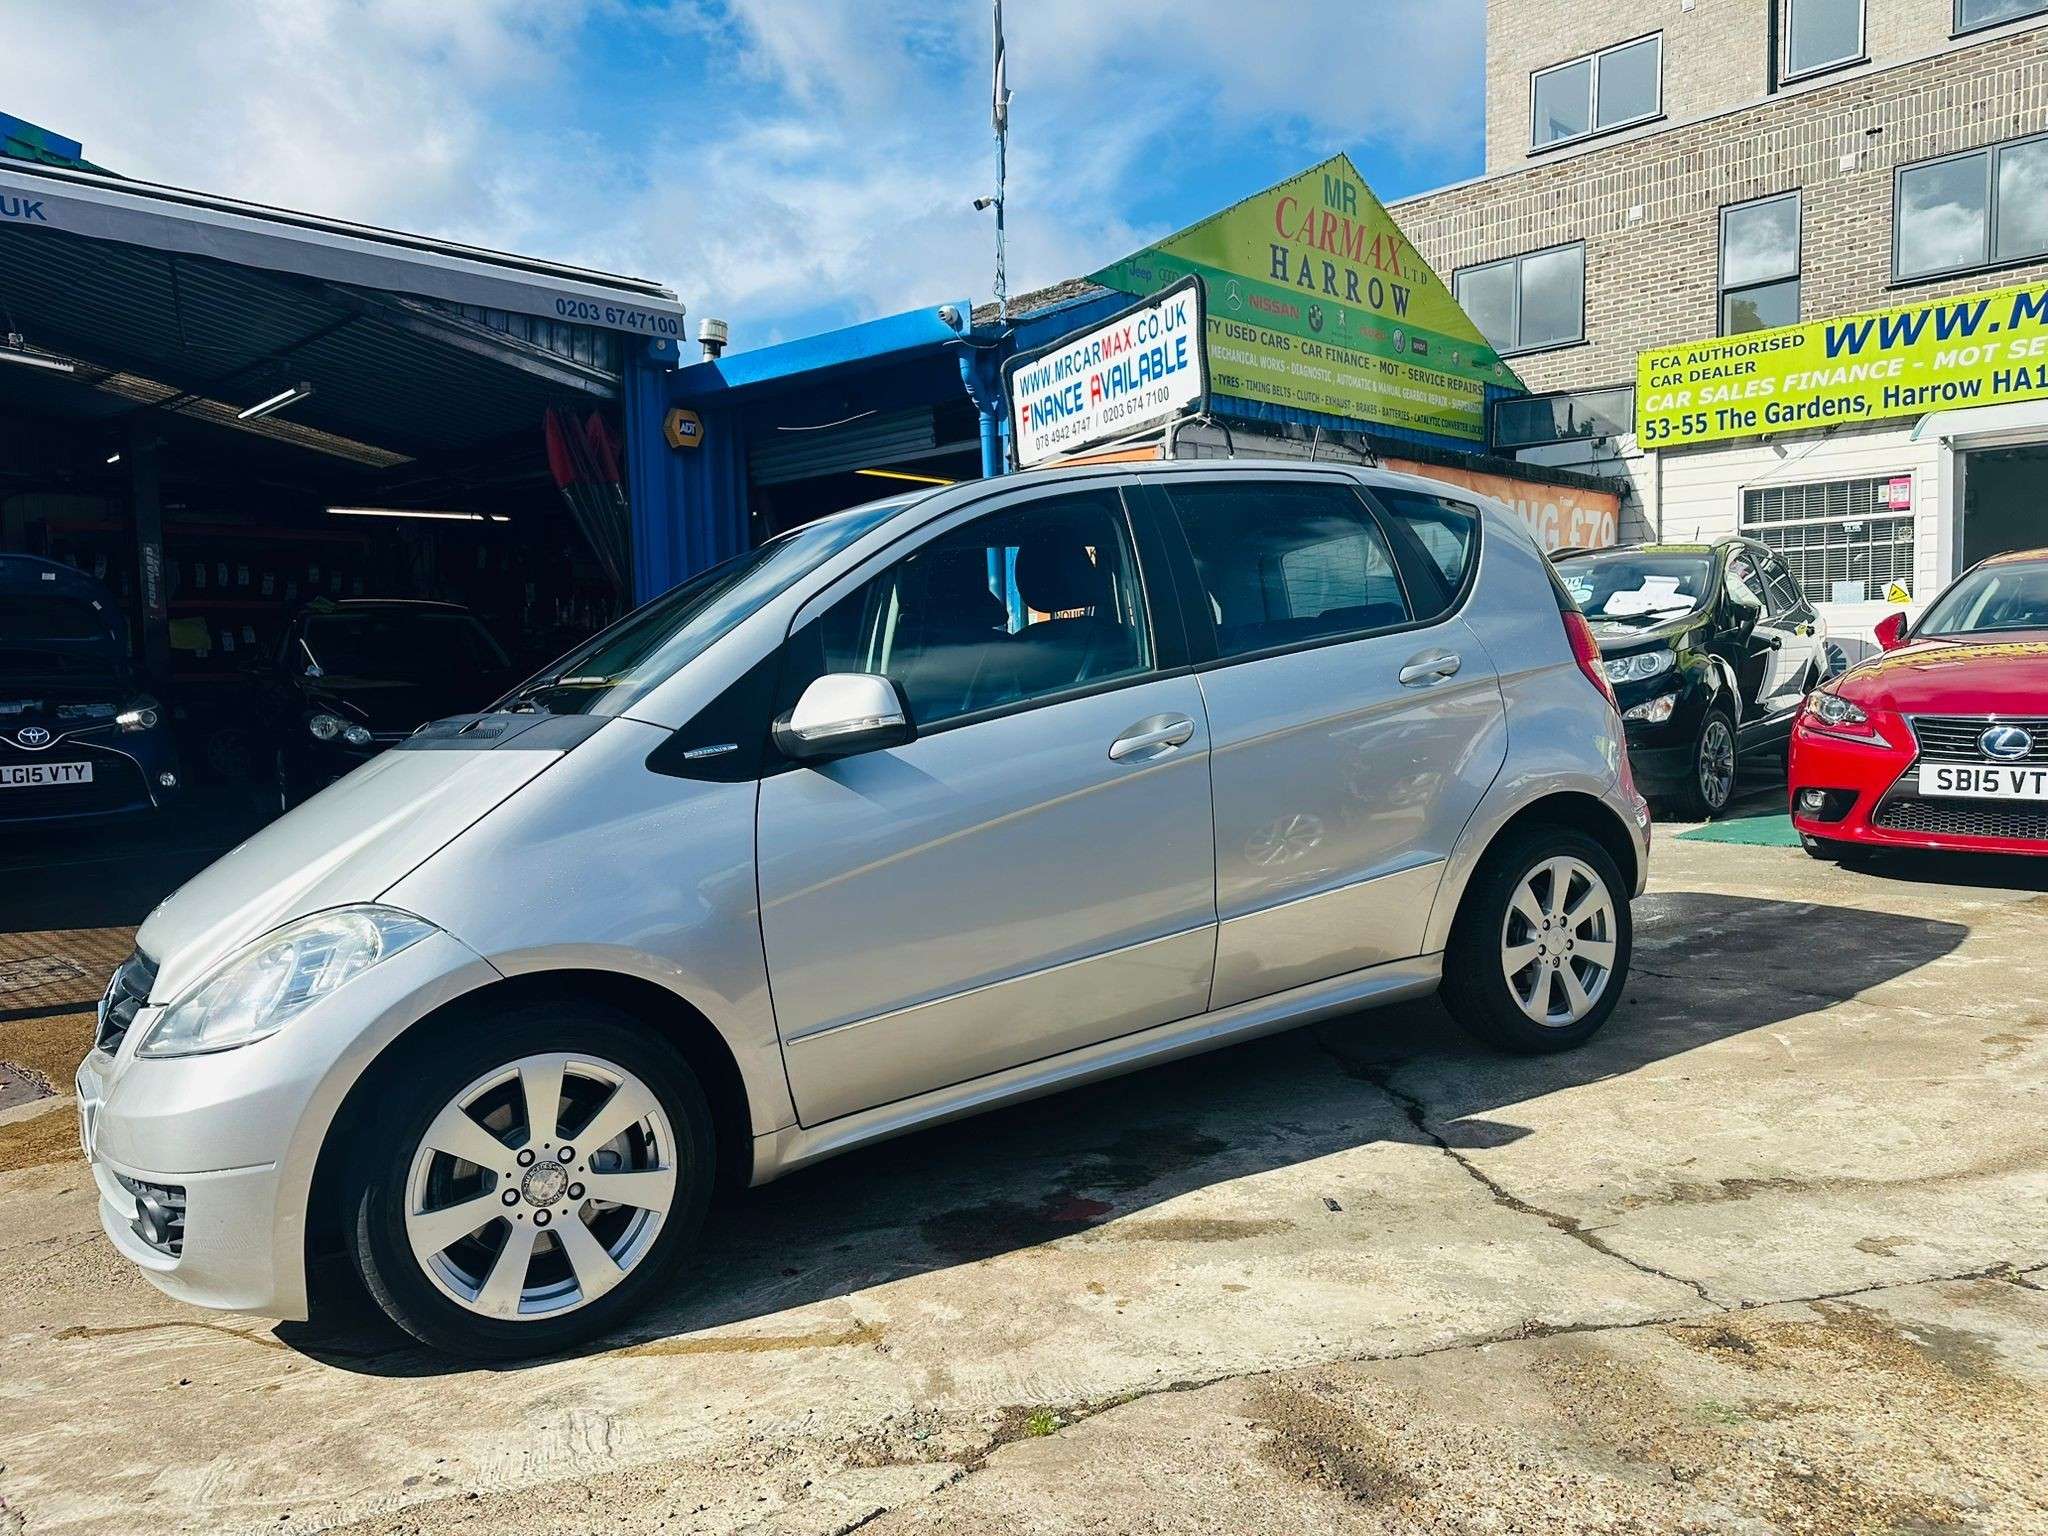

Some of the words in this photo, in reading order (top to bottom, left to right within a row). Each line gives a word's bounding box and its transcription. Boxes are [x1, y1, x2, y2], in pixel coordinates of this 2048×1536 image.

[1324, 174, 1357, 216] MR
[1275, 196, 1403, 276] CARMAX
[1403, 266, 1428, 285] LTD
[1129, 261, 1152, 282] Jeep
[1270, 243, 1411, 318] HARROW
[555, 298, 600, 321] 0203
[605, 307, 678, 334] 6747100
[1249, 294, 1300, 320] NISSAN
[1019, 300, 1187, 398] WWW.MRCARMAX.CO.UK
[1211, 344, 1258, 367] MECHANICAL
[1260, 356, 1285, 372] WORKS
[1225, 323, 1257, 343] USED
[1261, 332, 1290, 350] CARS
[1301, 342, 1322, 359] CAR
[1325, 347, 1370, 369] FINANCE
[1380, 360, 1399, 376] MOT
[1408, 368, 1445, 387] SERVICE
[1447, 378, 1483, 395] REPAIRS
[1650, 356, 1682, 371] FCA
[1687, 334, 1805, 365] AUTHORISED
[1021, 381, 1084, 437] FINANCE
[1091, 335, 1188, 409] AVAILABLE
[1645, 390, 1692, 413] CAR
[1699, 377, 1776, 405] SALES
[1782, 358, 1904, 393] FINANCE
[1933, 343, 2001, 370] MOT
[2007, 335, 2048, 360] SE
[1650, 373, 1683, 388] CAR
[1689, 361, 1757, 383] DEALER
[1218, 373, 1240, 389] TYRES
[1246, 379, 1271, 394] TIMING
[1272, 384, 1291, 399] BELTS
[1297, 389, 1320, 404] CLUTCH
[1325, 395, 1350, 409] EXHAUST
[1356, 401, 1377, 415] BRAKES
[1382, 406, 1410, 421] BATTERIES
[1645, 412, 1708, 441] 53-55
[1715, 407, 1757, 431] The
[1765, 393, 1873, 425] Gardens,
[1883, 379, 1982, 409] Harrow
[1993, 364, 2048, 395] HA1
[680, 421, 697, 435] ADT
[1035, 433, 1050, 451] 078
[1051, 425, 1070, 444] 4942
[1072, 416, 1091, 437] 4747
[1103, 403, 1125, 424] 0203
[1126, 399, 1144, 415] 674
[1146, 386, 1170, 408] 7100
[0, 767, 43, 785] LG15
[49, 764, 85, 782] VTY
[1936, 768, 2000, 793] SB15
[2009, 770, 2047, 795] VT
